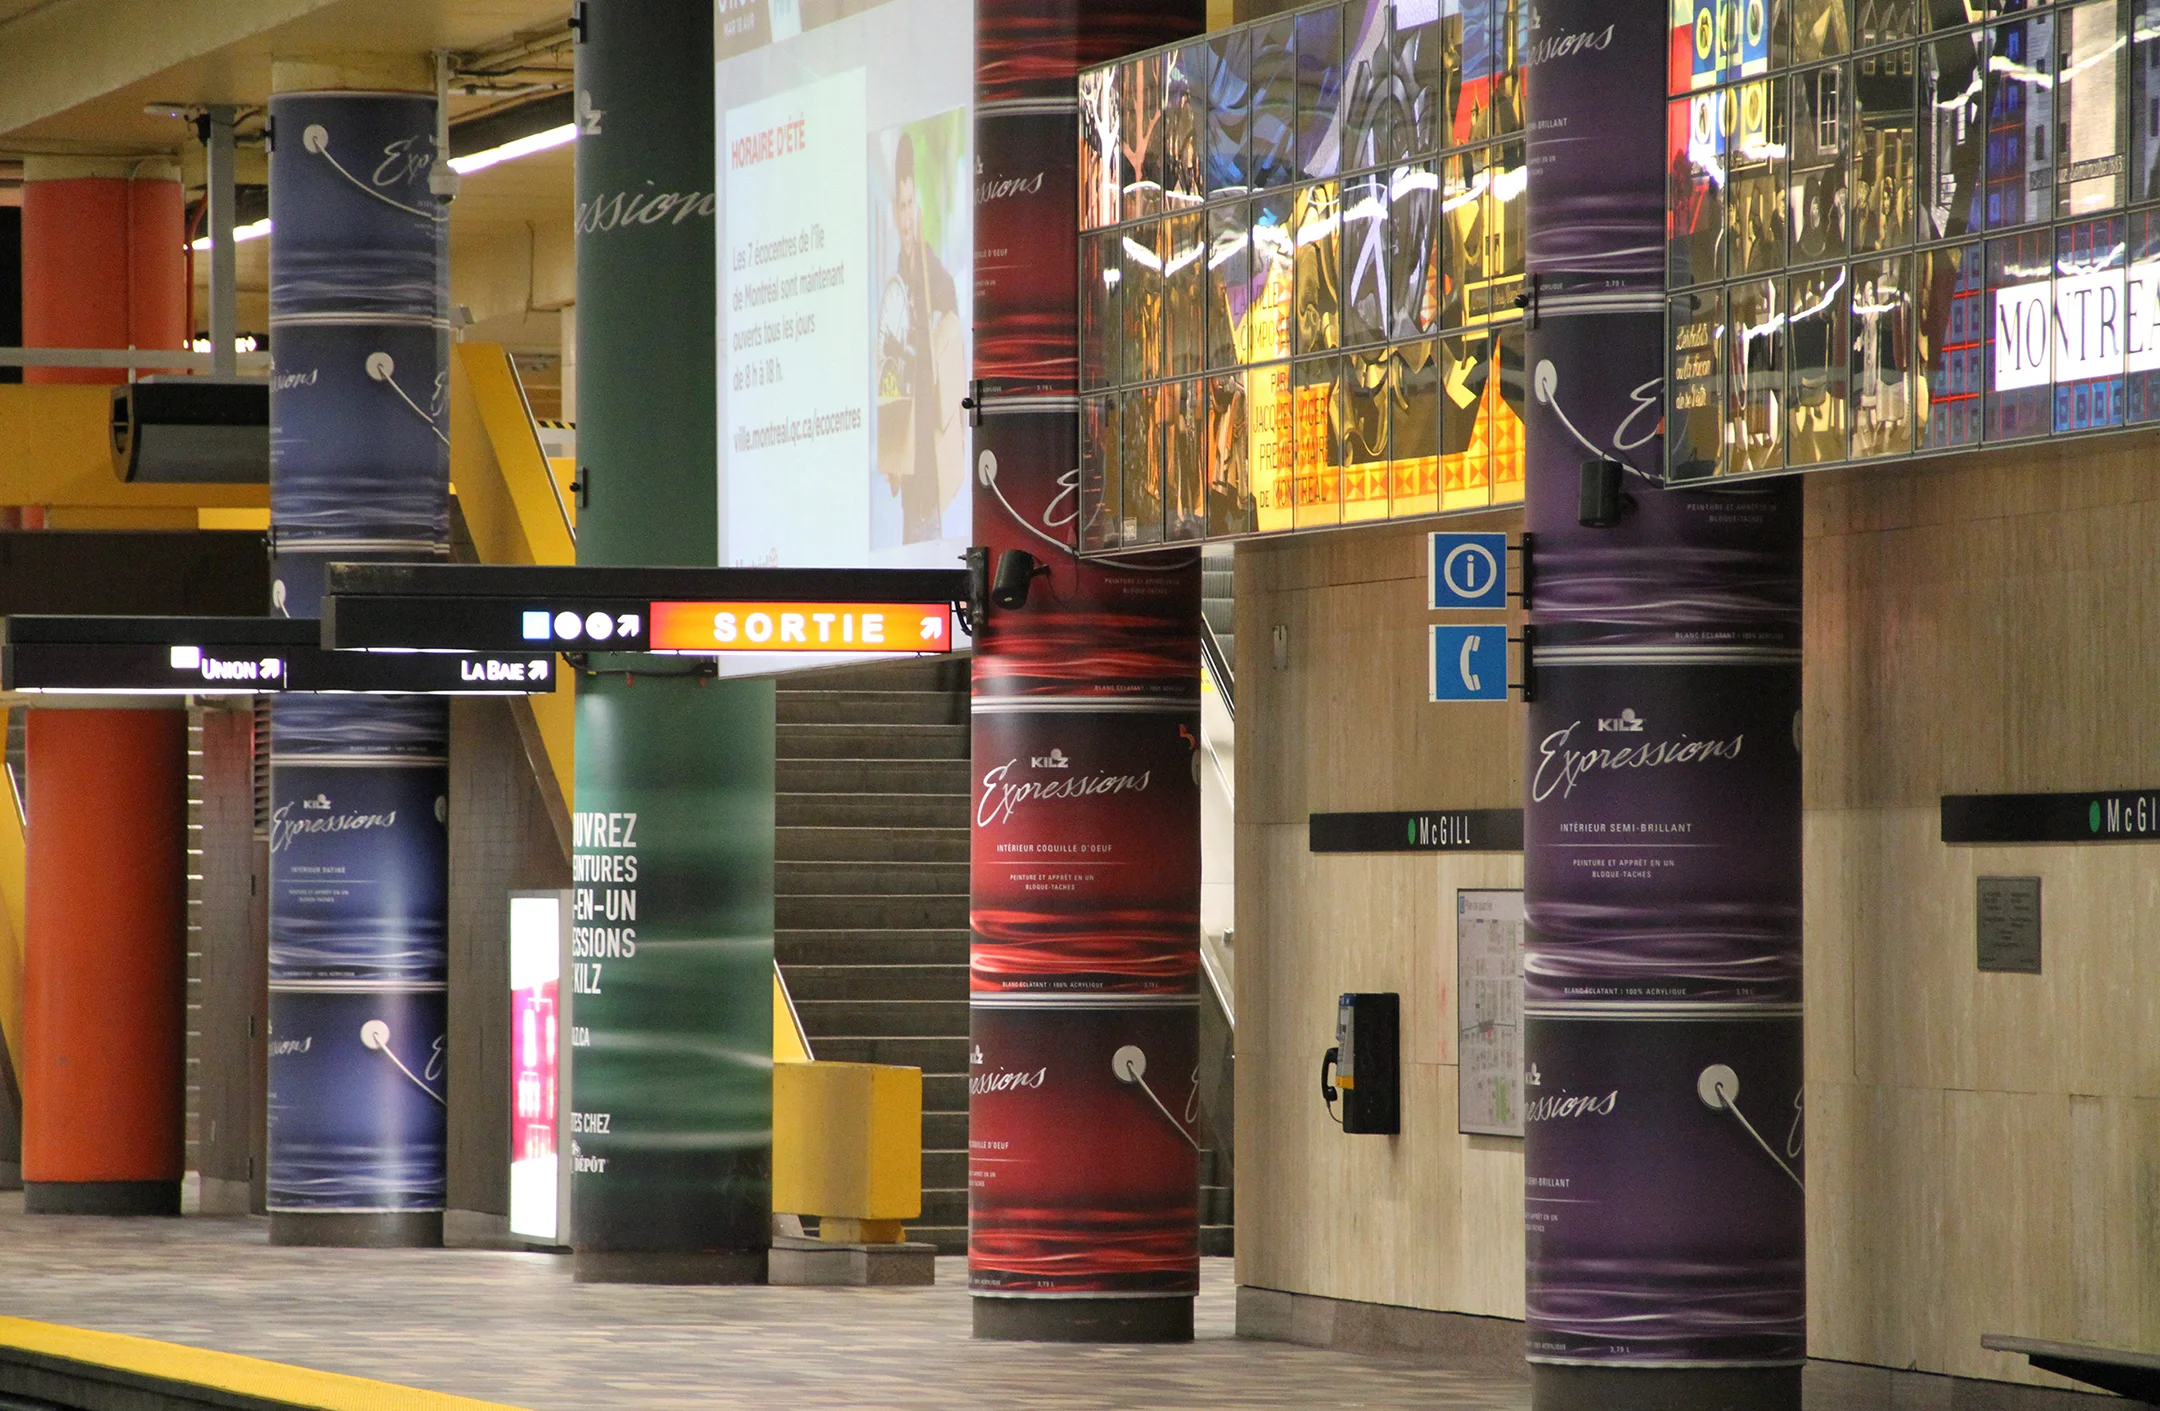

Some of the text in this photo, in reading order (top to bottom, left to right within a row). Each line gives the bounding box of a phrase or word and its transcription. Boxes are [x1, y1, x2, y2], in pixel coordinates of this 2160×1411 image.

[732, 111, 806, 170] HORAIRE D'ÉTÉ
[733, 245, 747, 272] Les
[755, 233, 798, 266] écocentres
[799, 227, 810, 254] de
[733, 260, 845, 312] de Montréal sont maintenant
[733, 311, 816, 352] ouverts tous les jours
[733, 364, 744, 391] de
[745, 362, 751, 389] 8
[752, 360, 758, 387] h
[766, 358, 775, 384] 18
[1260, 490, 1270, 508] DE
[713, 611, 886, 644] SORTIE
[201, 654, 257, 681] UNION
[461, 659, 525, 683] LA BAIE
[1598, 717, 1644, 732] KILZ
[1031, 756, 1069, 769] KILZ
[1532, 720, 1744, 803] Expressions
[976, 758, 1151, 828] Expressions
[271, 801, 397, 853] Expressions
[1419, 815, 1471, 846] McGILL
[1560, 822, 1693, 833] INTÉRIEUR SEMI-BRILLANT
[996, 842, 1113, 853] INTÉRIEUR COQUILLE D'OEUF
[1572, 857, 1675, 867] PEINTURE ET APPRÊT EN UN
[1009, 874, 1037, 882] PEINTURE
[1038, 874, 1046, 882] ET
[1084, 874, 1095, 882] UN
[1591, 870, 1652, 879] BLOQUE-TACHES
[1024, 883, 1076, 891] BLOQUE-TACHES
[1069, 981, 1104, 989] ACRYLIQUE
[1564, 986, 1584, 995] BLANC
[1584, 986, 1619, 995] ÉCLATANT
[1624, 987, 1644, 996] 100%
[1645, 987, 1687, 996] ACRYLIQUE
[583, 1113, 611, 1135] CHEZ
[575, 1154, 606, 1174] DÉPÔT
